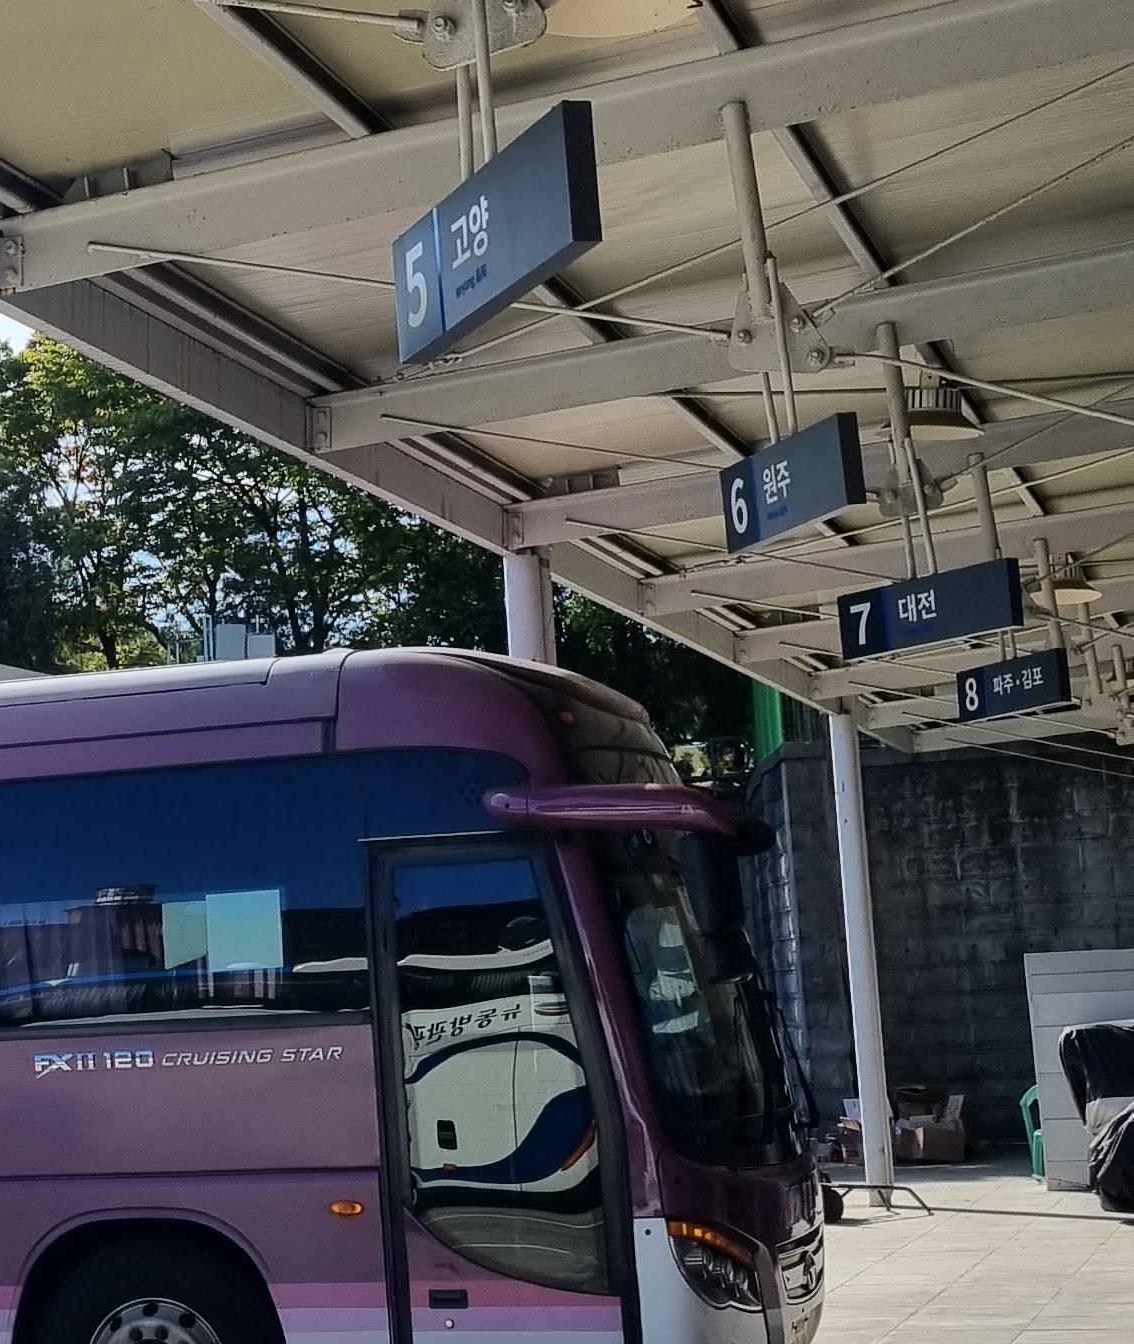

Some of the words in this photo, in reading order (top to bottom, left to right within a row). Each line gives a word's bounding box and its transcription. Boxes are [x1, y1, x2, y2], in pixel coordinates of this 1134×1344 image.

[406, 241, 427, 328] 5
[450, 194, 489, 270] 고양
[730, 477, 748, 534] 6
[763, 460, 791, 505] 원주
[849, 601, 871, 646] 7
[897, 588, 937, 622] 대전
[965, 677, 979, 712] 8
[103, 1050, 154, 1069] 120
[161, 1049, 273, 1068] CRUISING
[280, 1045, 343, 1063] STAR
